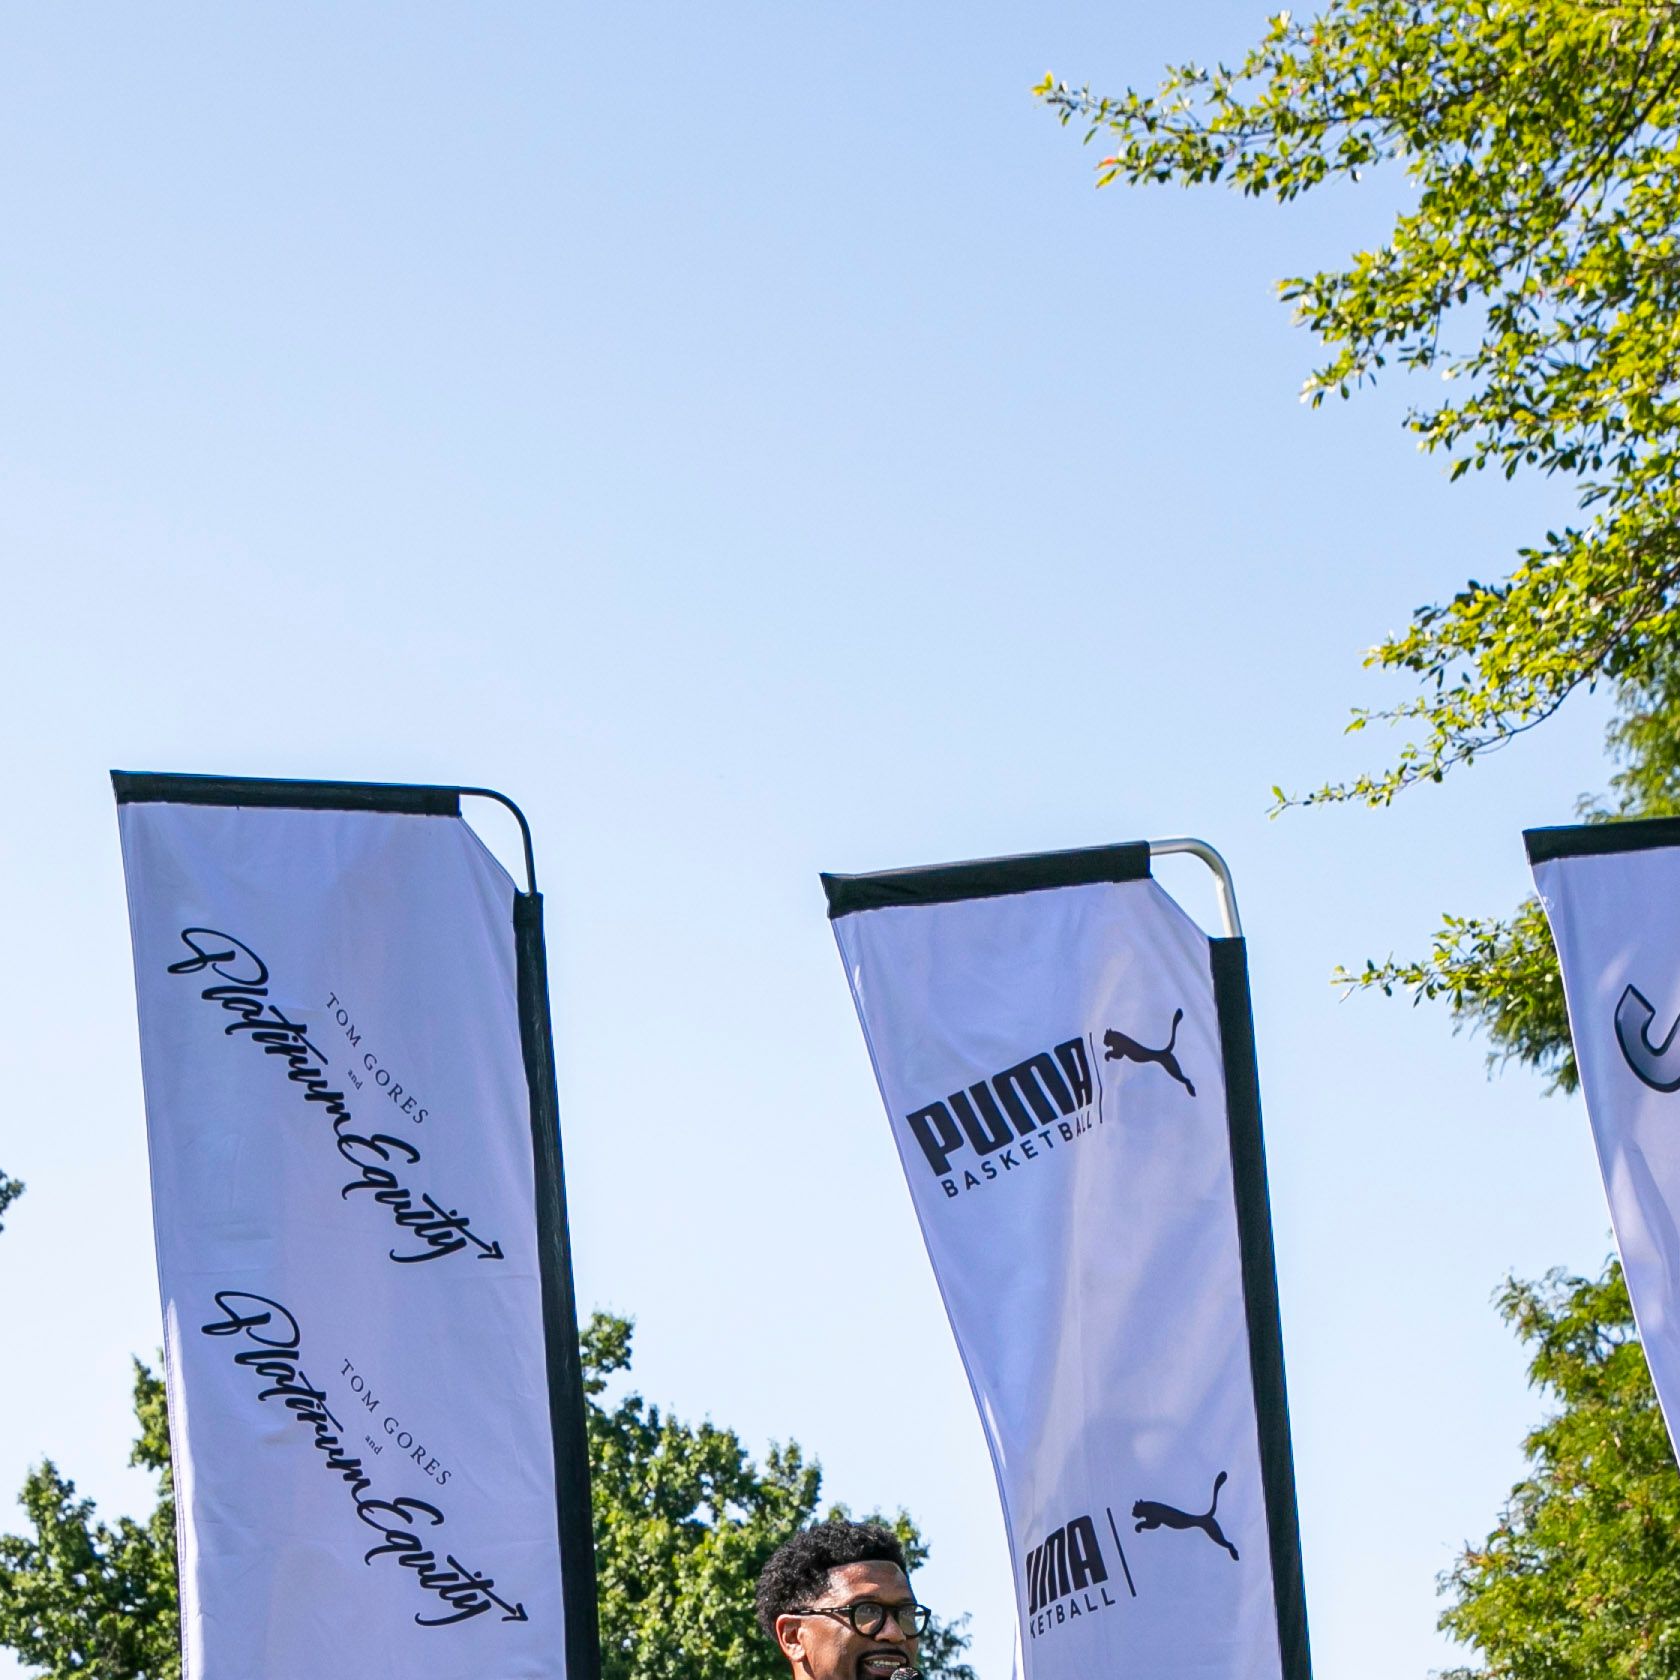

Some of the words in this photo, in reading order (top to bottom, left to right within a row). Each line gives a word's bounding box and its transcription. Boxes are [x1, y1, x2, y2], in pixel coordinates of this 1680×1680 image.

[326, 992, 361, 1050] TOM
[362, 1053, 428, 1125] GORES
[347, 1069, 363, 1091] and
[906, 1036, 1093, 1176] PUMA
[941, 1111, 1093, 1199] BASKETBALL
[340, 1358, 378, 1414] TOM
[382, 1415, 452, 1488] GORES
[365, 1434, 383, 1455] and
[1026, 1515, 1108, 1616] UMA
[1029, 1588, 1116, 1639] KETBALL
